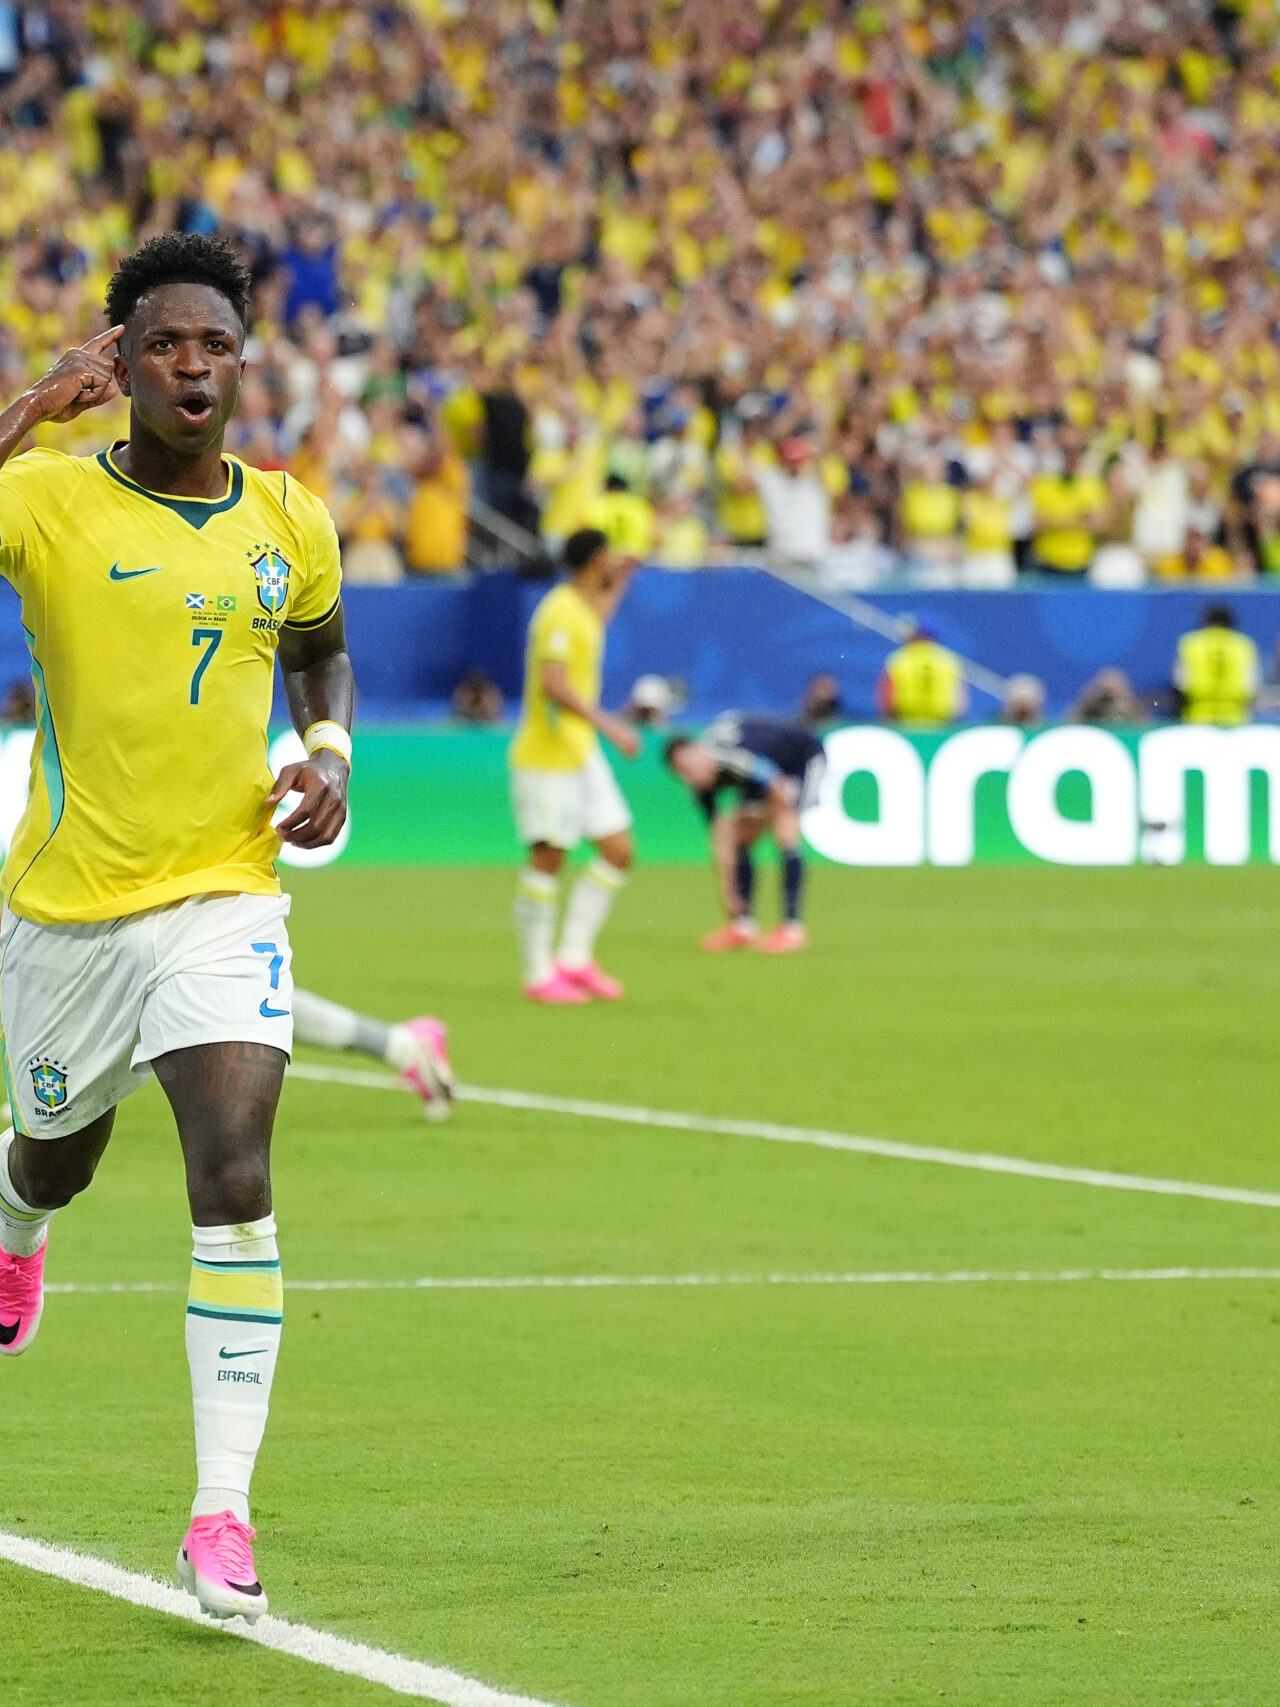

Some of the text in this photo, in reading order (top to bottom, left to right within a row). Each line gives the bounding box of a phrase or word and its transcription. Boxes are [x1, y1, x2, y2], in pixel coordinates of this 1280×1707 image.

[266, 577, 281, 585] CBF
[190, 628, 223, 706] 7
[250, 942, 284, 990] 7
[35, 1106, 72, 1117] BRASIL
[217, 1370, 263, 1385] BRASIL
